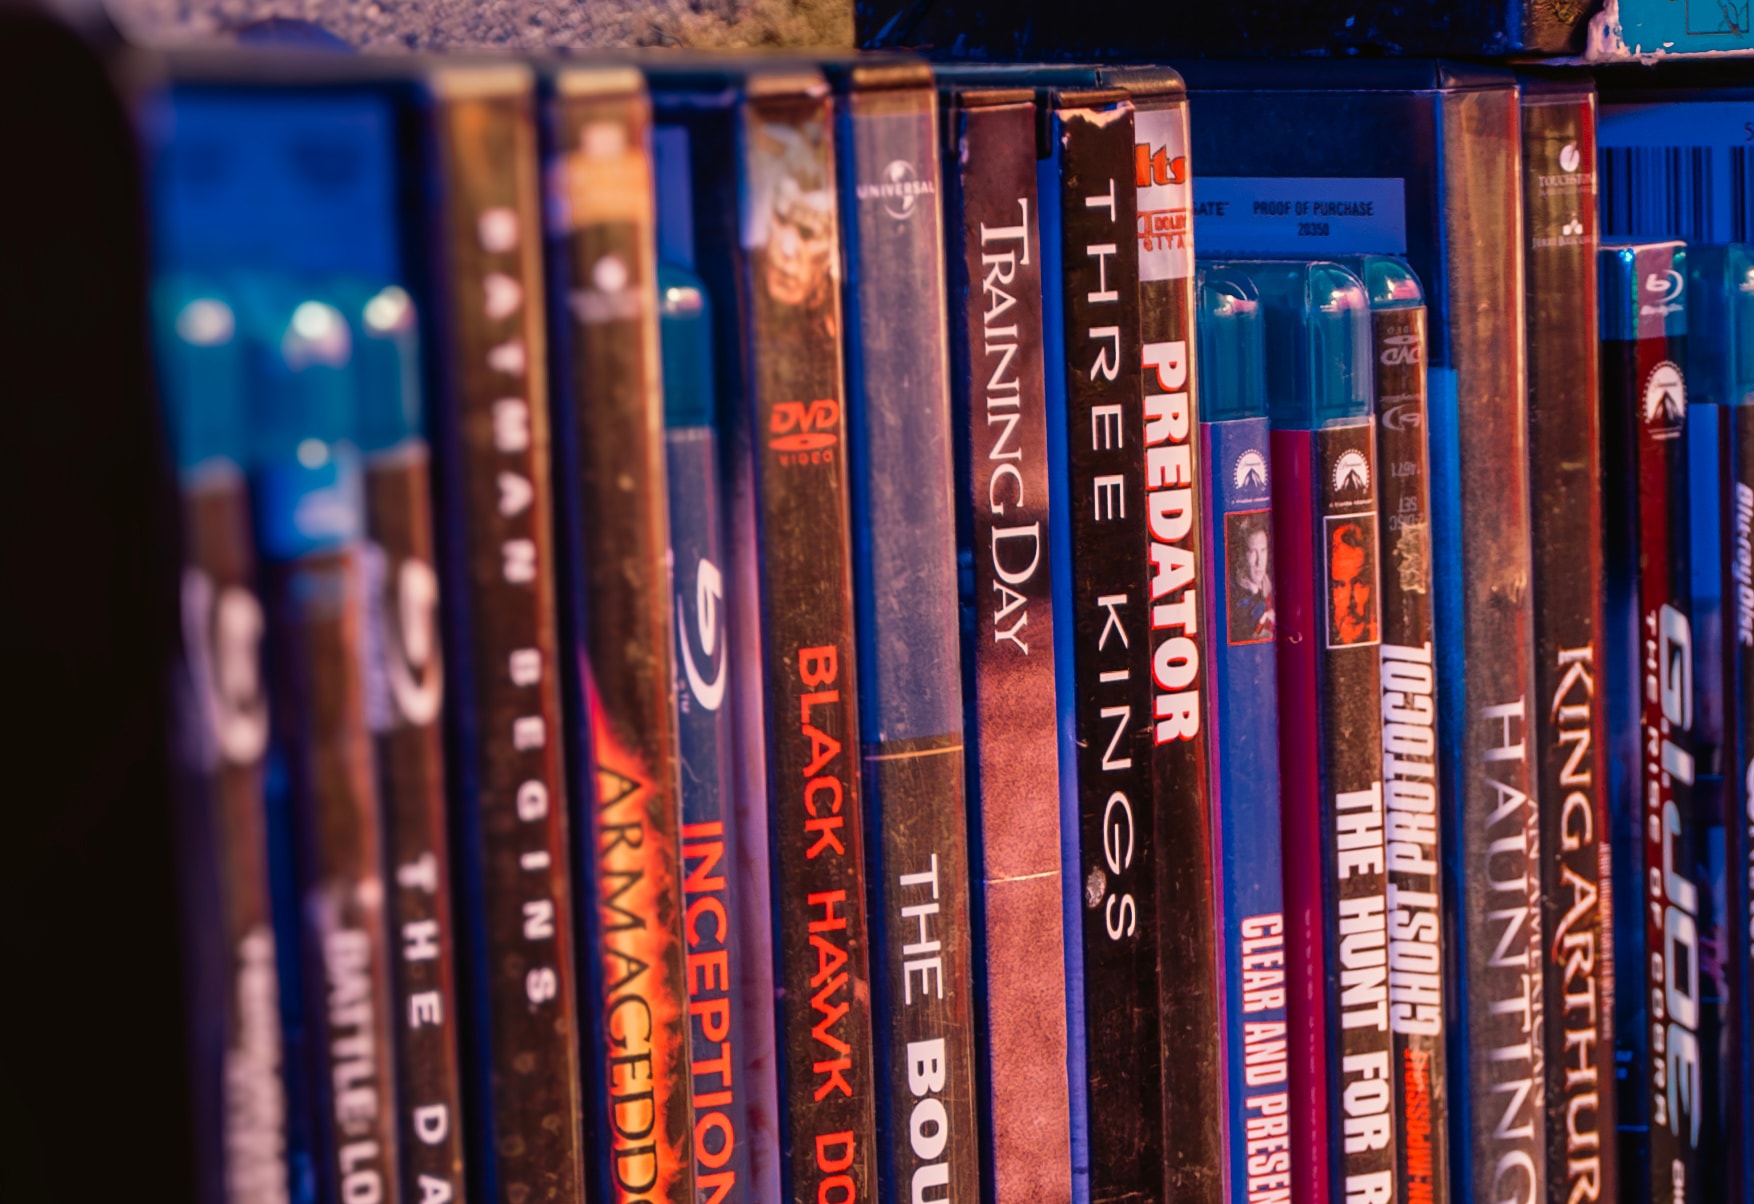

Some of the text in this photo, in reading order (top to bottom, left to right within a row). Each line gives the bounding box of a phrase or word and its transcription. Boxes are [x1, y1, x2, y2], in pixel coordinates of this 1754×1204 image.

[856, 179, 936, 197] UNIVERSAL
[1253, 201, 1374, 217] PROOF OF PURCHASE
[769, 399, 840, 434] DVD
[980, 198, 1041, 655] TRAINING DAY
[478, 206, 557, 1004] BATMAN BEGINS
[1085, 178, 1136, 942] THREE KINGS
[1142, 340, 1202, 746] PREDATOR
[798, 645, 846, 860] BLACK
[1381, 642, 1438, 876] PROTOCOL
[1552, 644, 1595, 852] KING
[1335, 780, 1385, 880] THE
[396, 852, 444, 1029] THE
[806, 889, 854, 1102] HAWK
[897, 853, 944, 1006] THE
[1240, 913, 1286, 1013] CLEAR
[1338, 895, 1389, 1032] HUNT
[1385, 884, 1442, 1036] GHOST
[1244, 1020, 1288, 1086] AND
[1343, 1050, 1391, 1154] FOR
